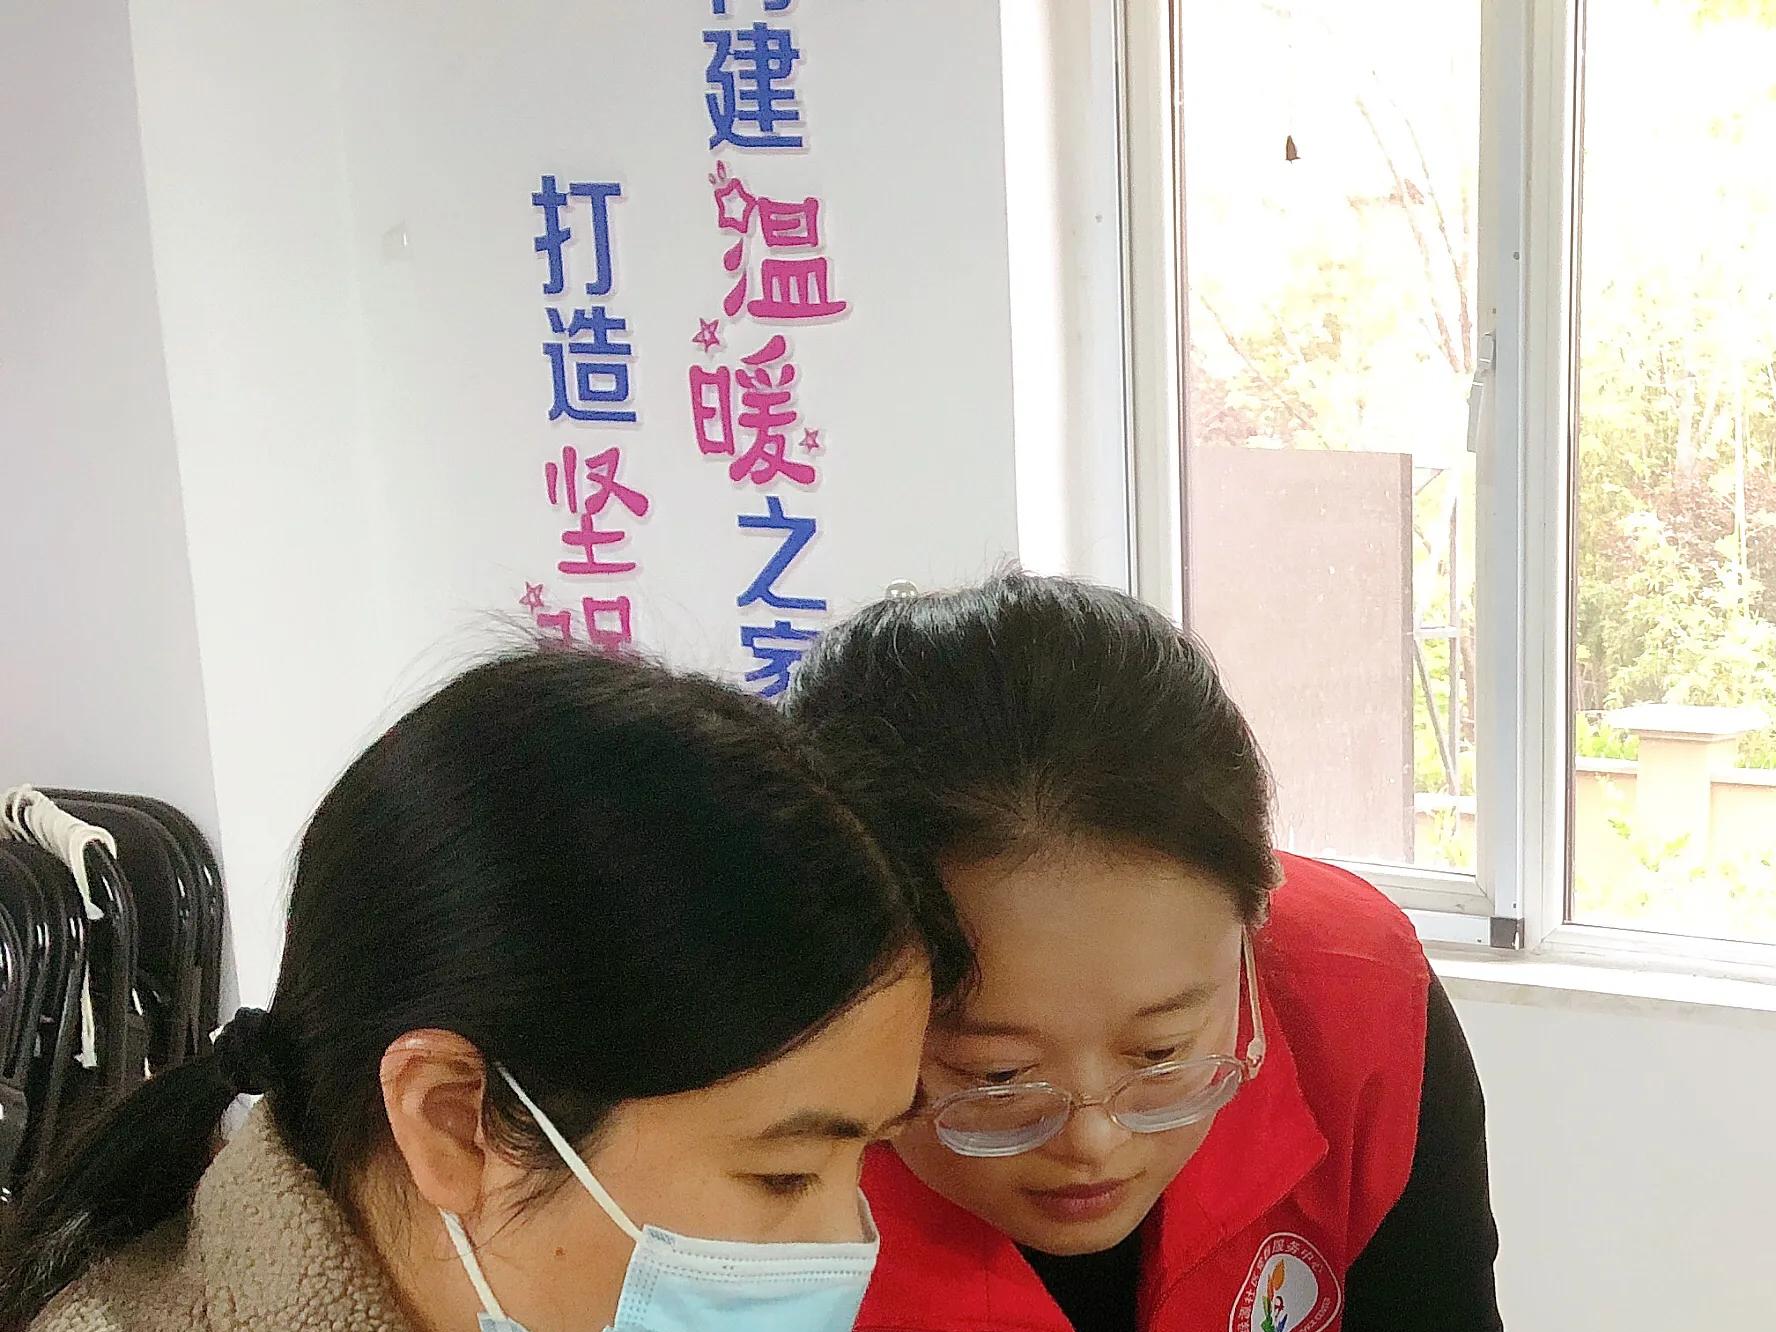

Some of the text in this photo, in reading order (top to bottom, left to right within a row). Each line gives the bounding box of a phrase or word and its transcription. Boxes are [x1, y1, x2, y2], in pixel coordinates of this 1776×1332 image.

[689, 0, 847, 697] 建温暖之家
